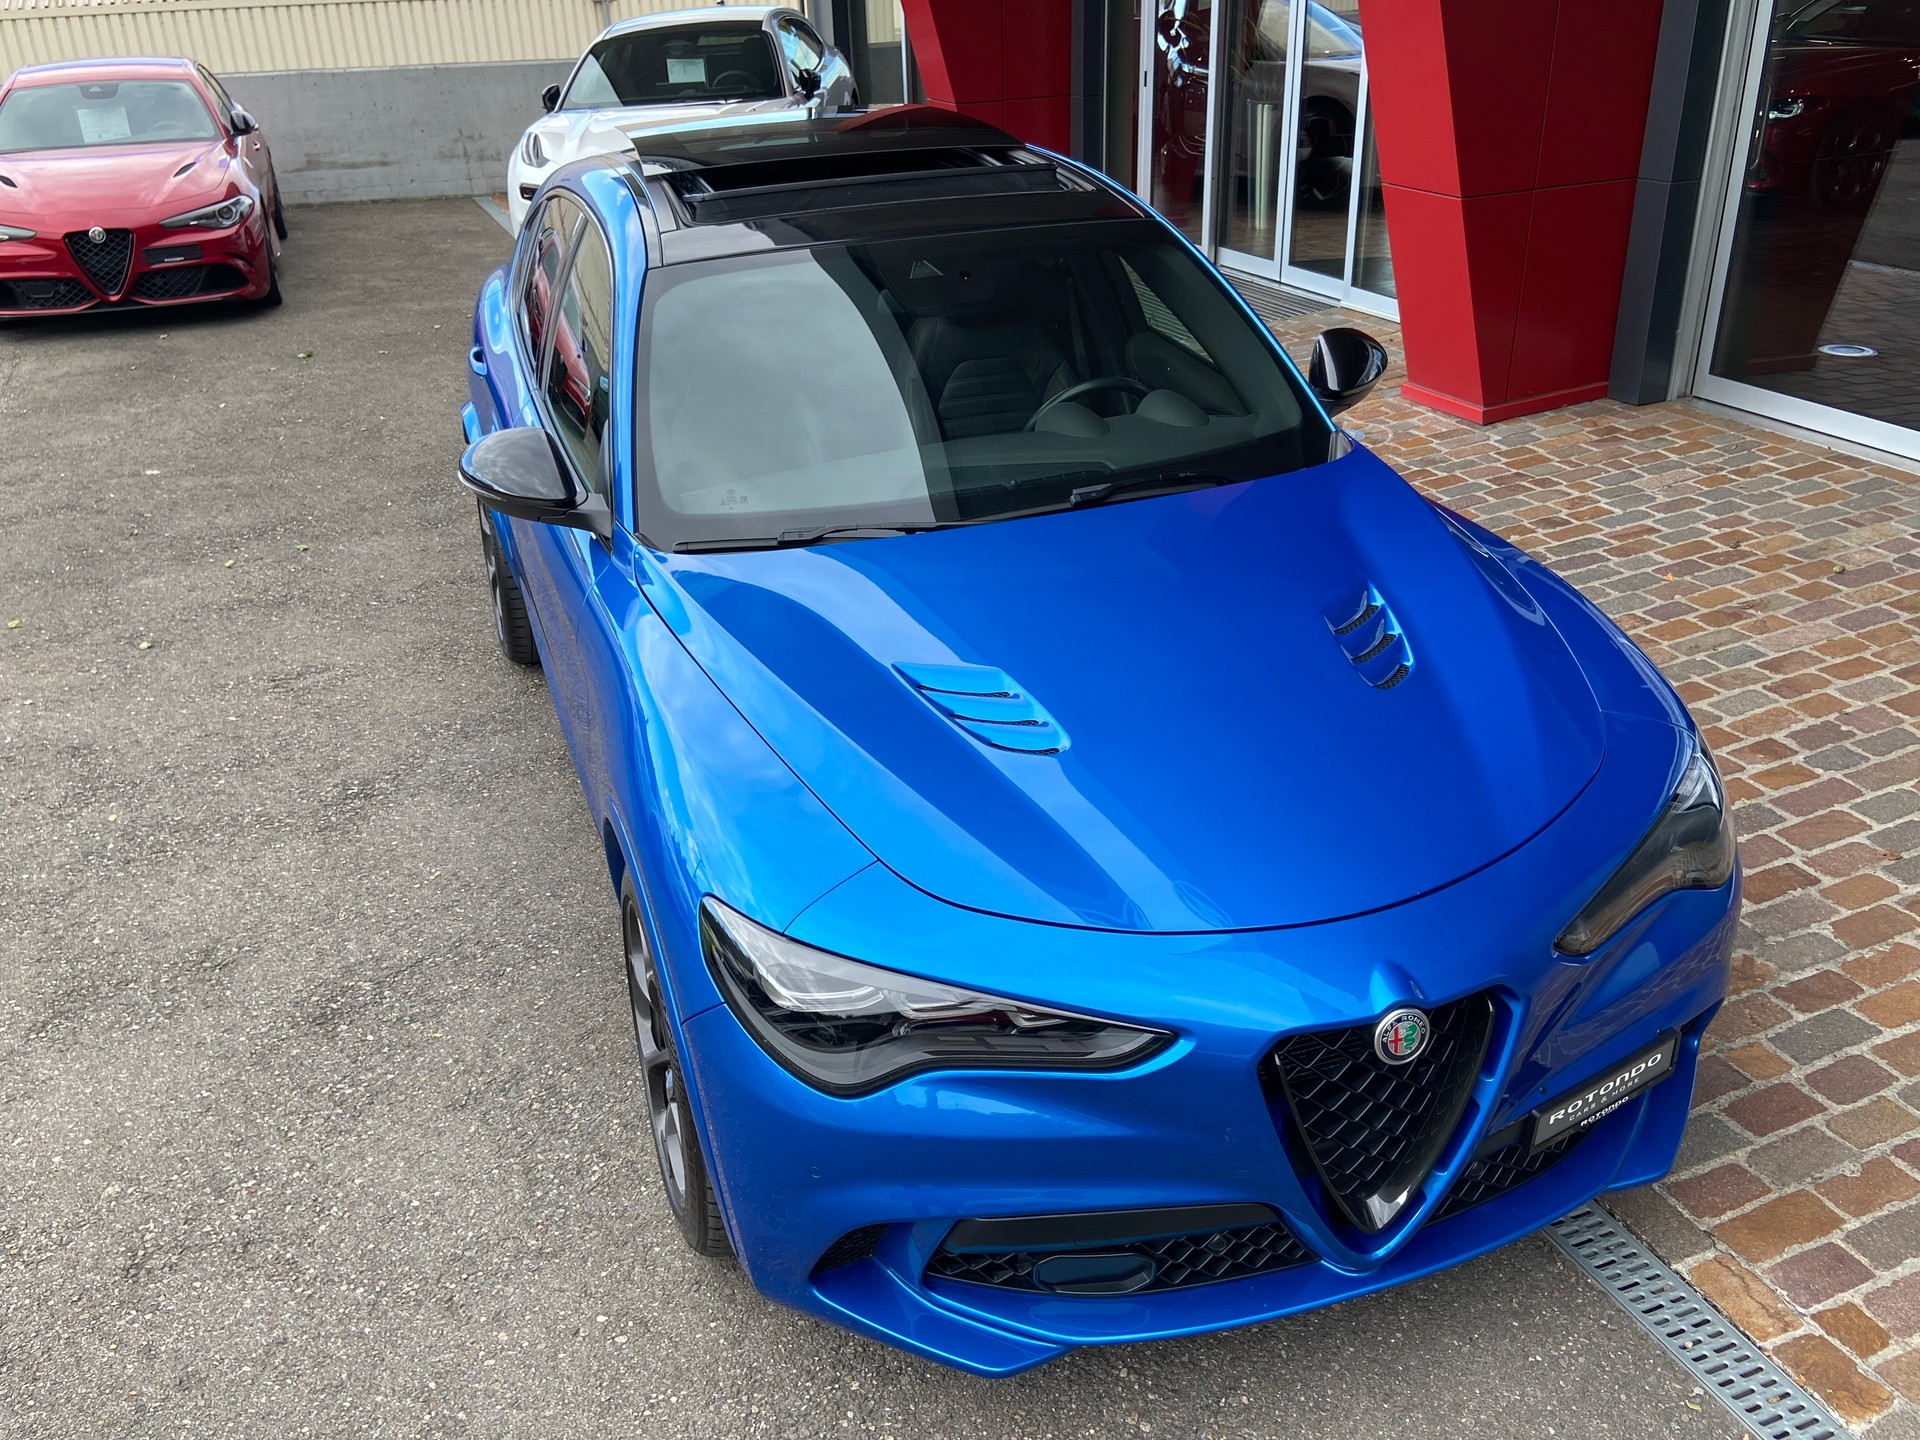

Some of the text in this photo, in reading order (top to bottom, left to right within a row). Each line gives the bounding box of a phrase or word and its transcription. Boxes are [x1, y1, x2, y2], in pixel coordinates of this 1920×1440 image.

[1382, 1015, 1426, 1043] ALFA ROMEO
[1549, 1053, 1662, 1125] ROTONDO
[1569, 1103, 1596, 1121] CARS
[1611, 1077, 1640, 1097] MORE
